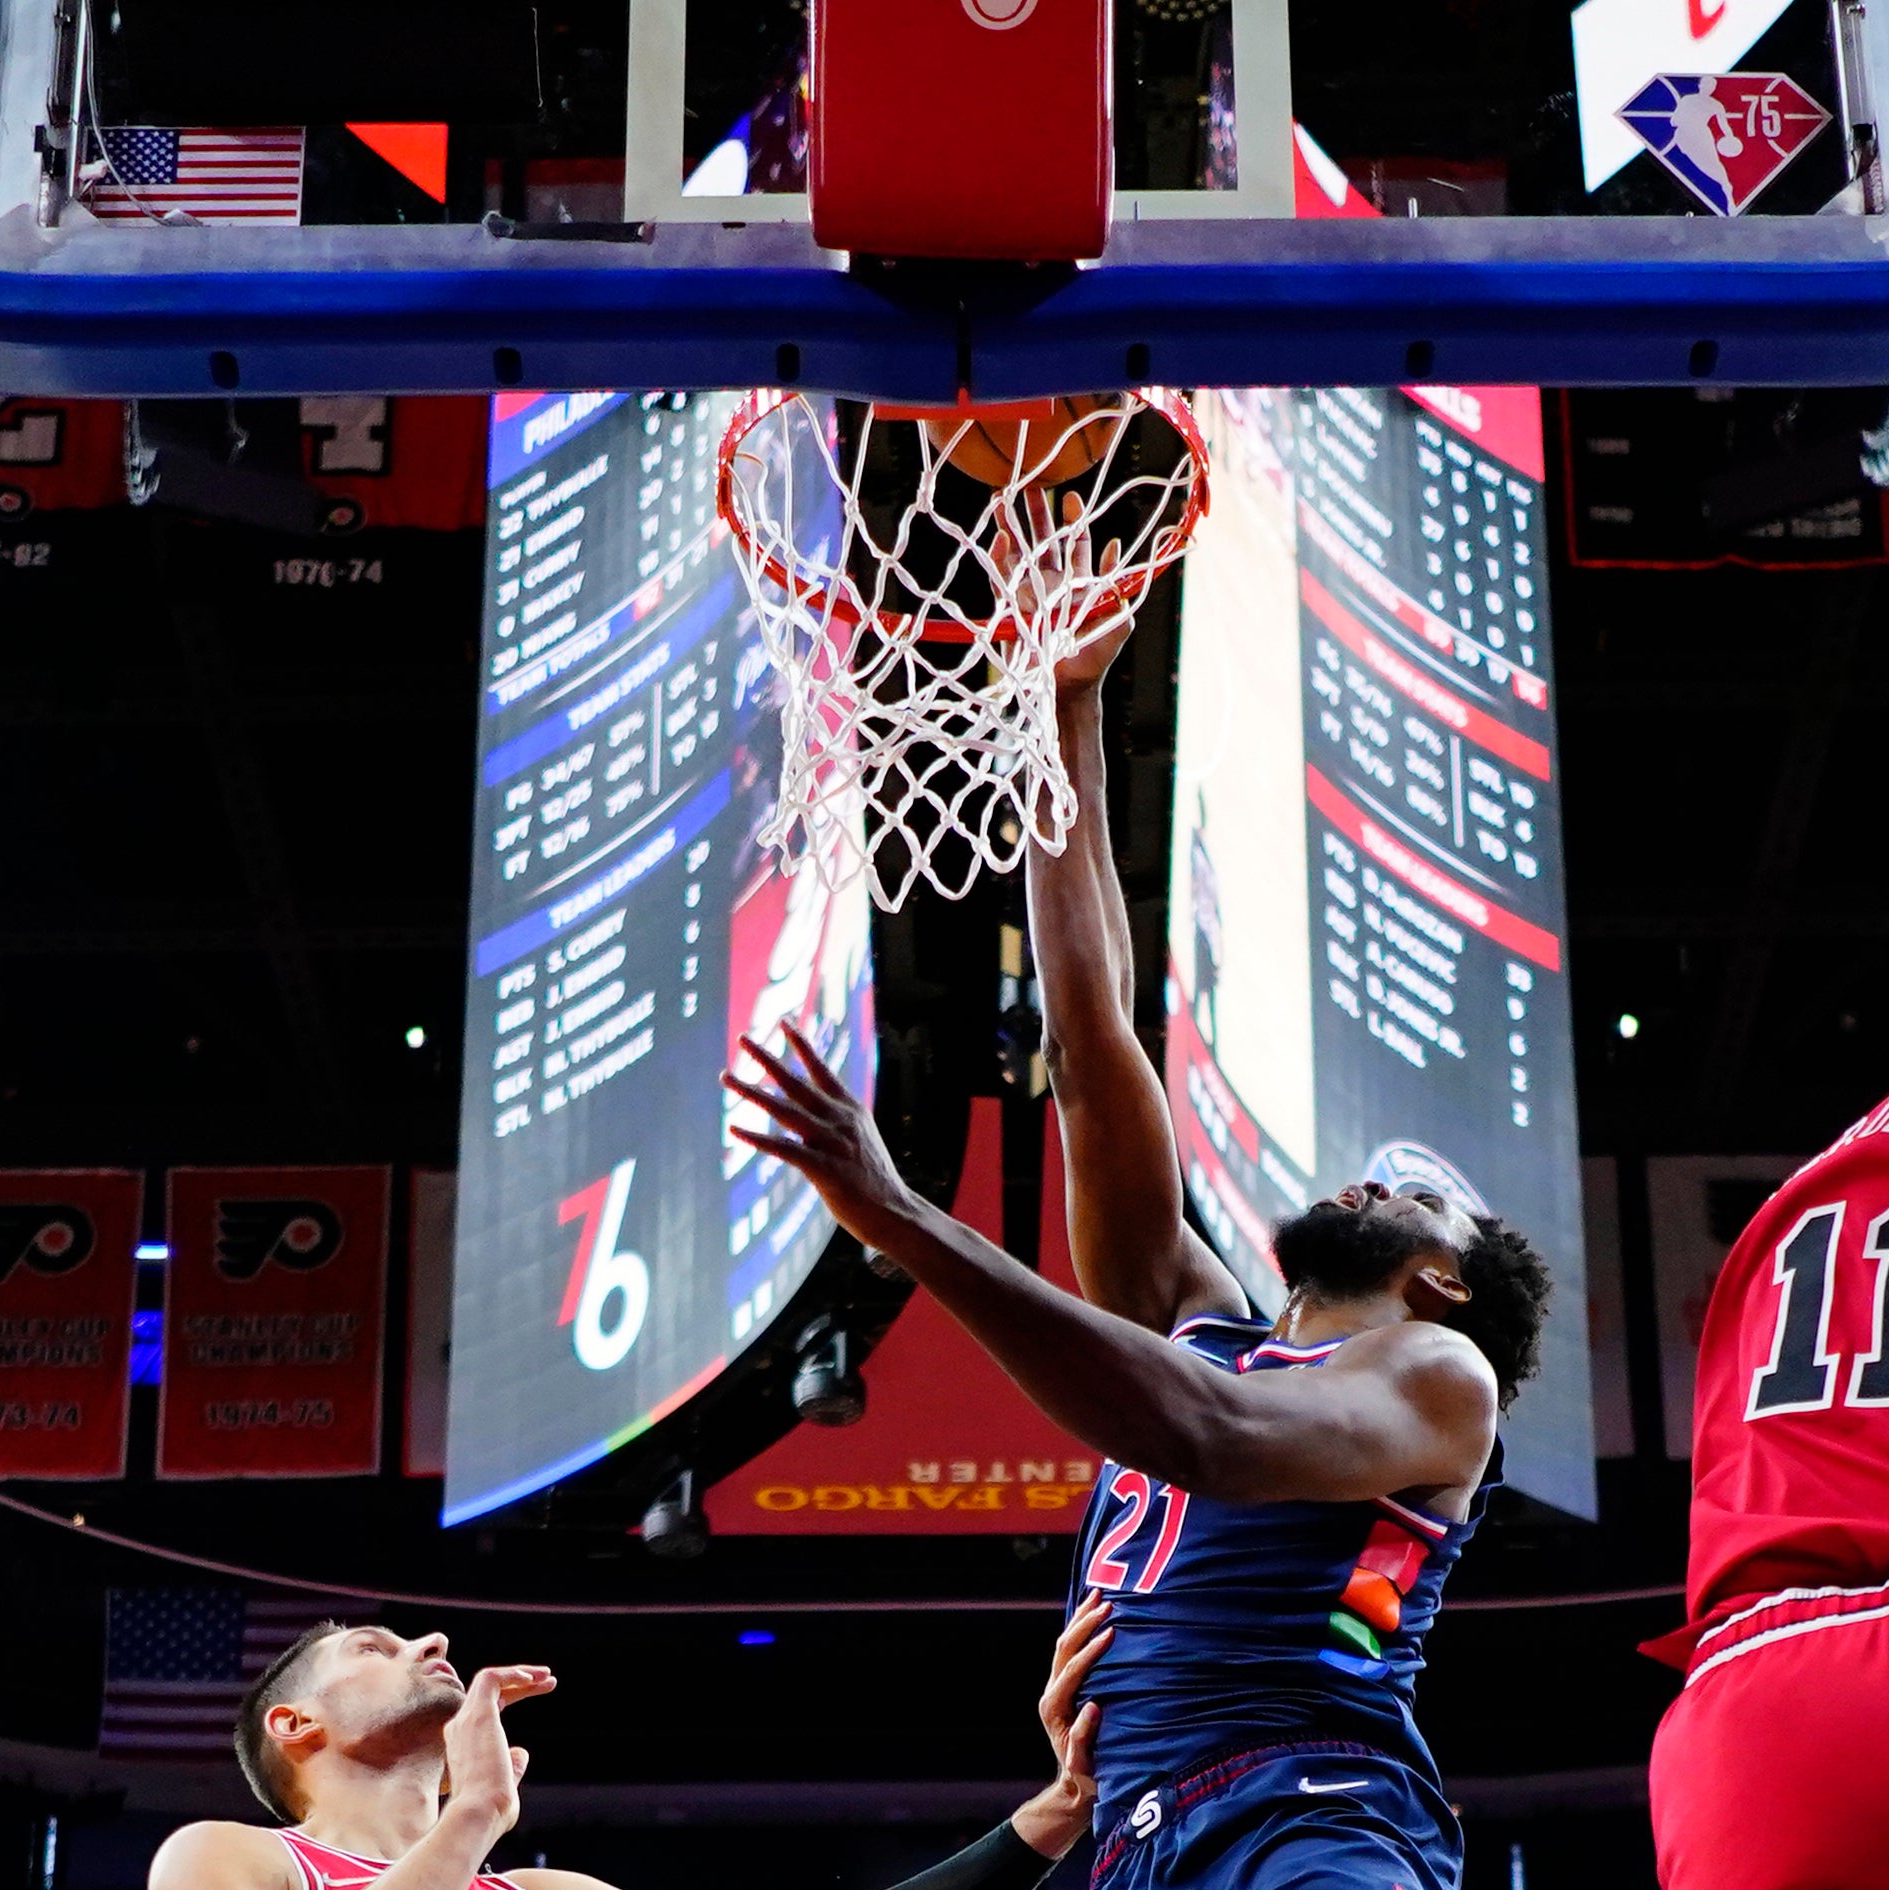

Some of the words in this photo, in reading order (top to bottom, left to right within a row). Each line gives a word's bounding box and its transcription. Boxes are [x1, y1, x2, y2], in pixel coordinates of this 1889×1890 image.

[1741, 95, 1781, 138] 75
[556, 1156, 651, 1371] 76
[204, 1399, 334, 1430] 1974-75
[908, 1459, 1092, 1485] ENTER
[755, 1485, 1008, 1512] FARGO
[1085, 1466, 1191, 1594] 21
